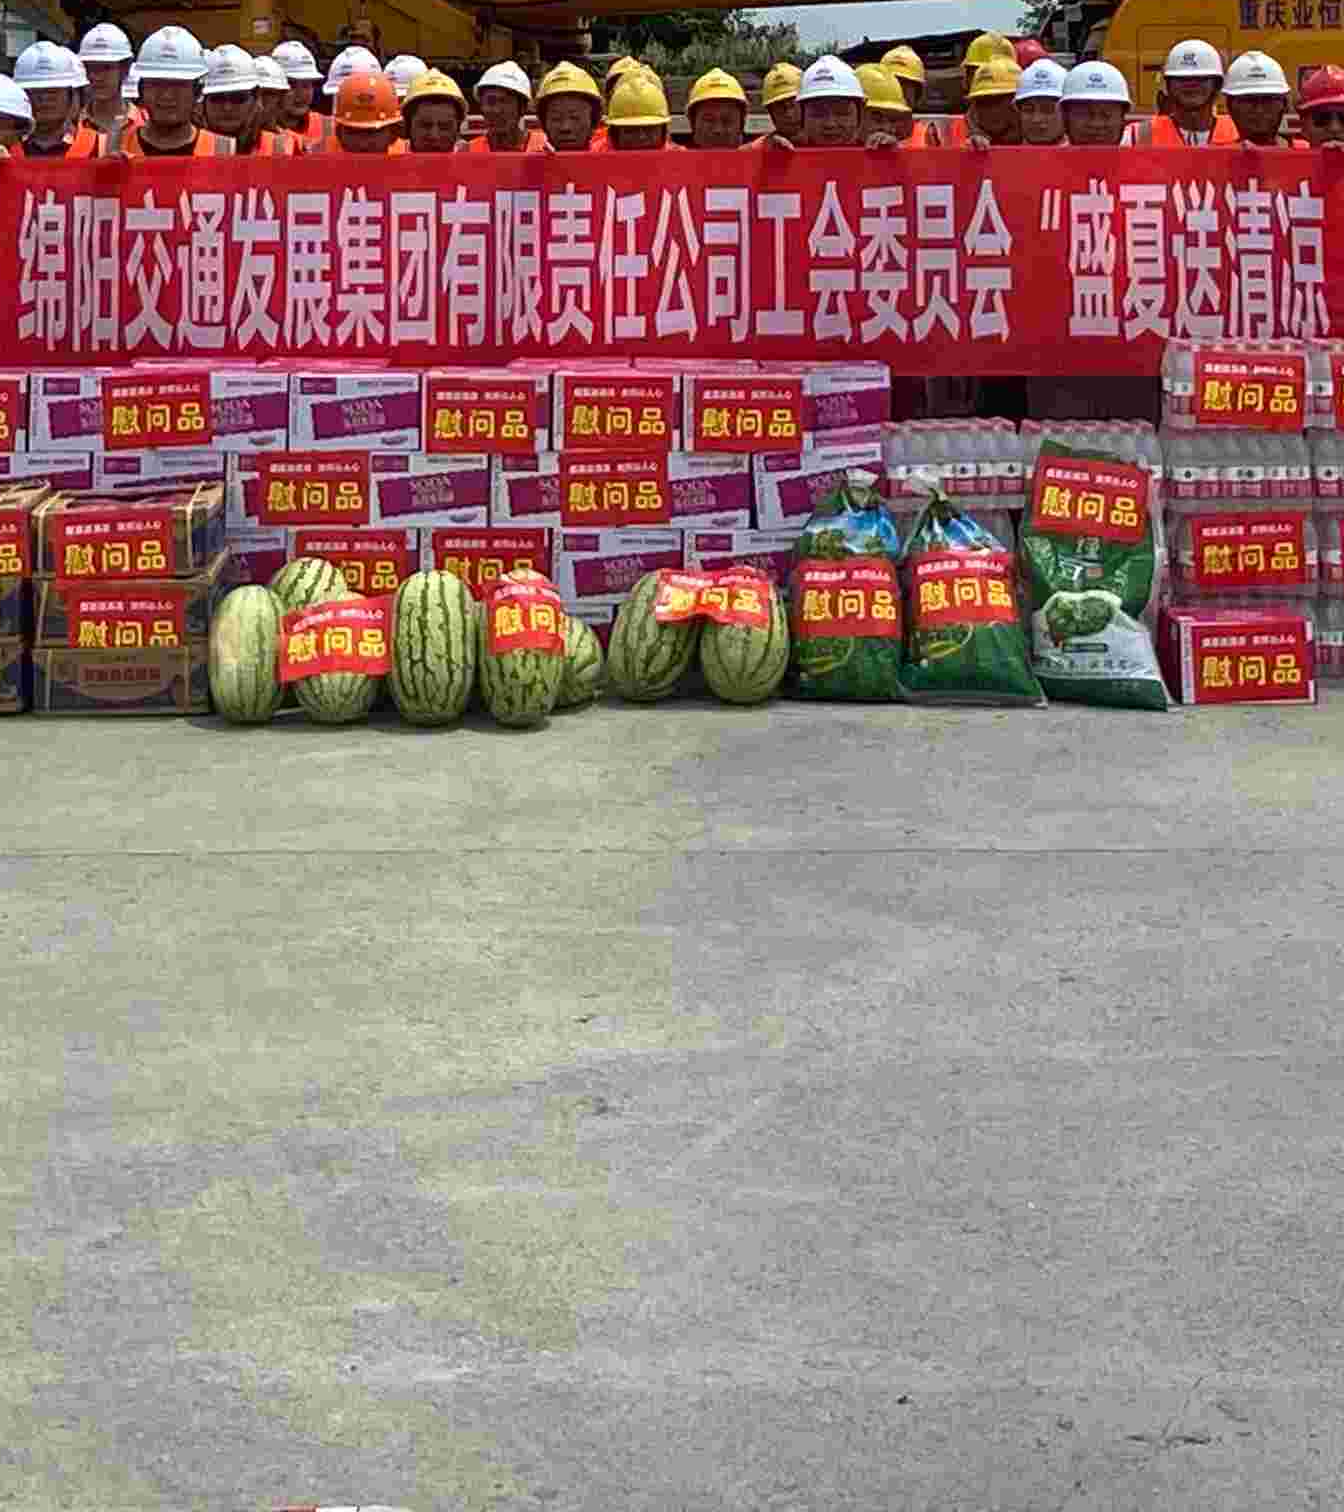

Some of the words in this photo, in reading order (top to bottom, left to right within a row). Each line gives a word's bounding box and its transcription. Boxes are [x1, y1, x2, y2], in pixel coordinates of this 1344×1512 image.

[17, 180, 1013, 350] 绵阳交通发展集团有限责任公司工会委员会
[1203, 381, 1298, 413] 慰问品
[112, 405, 205, 436] 慰问品
[434, 409, 527, 439] 慰问品
[572, 406, 665, 436] 慰问品
[702, 408, 796, 437] 慰问品
[267, 482, 362, 511] 慰问品
[569, 482, 662, 512] 慰问品
[1041, 487, 1138, 526] 慰问品
[63, 542, 166, 574] 慰问品
[1202, 543, 1298, 574] 慰问品
[345, 562, 399, 590] 问品
[803, 590, 897, 622] 慰问品
[920, 579, 1013, 611] 慰问品
[79, 621, 178, 648] 慰问品
[495, 602, 561, 637] 慰问
[287, 627, 385, 663] 慰问品
[1202, 656, 1301, 687] 慰问品
